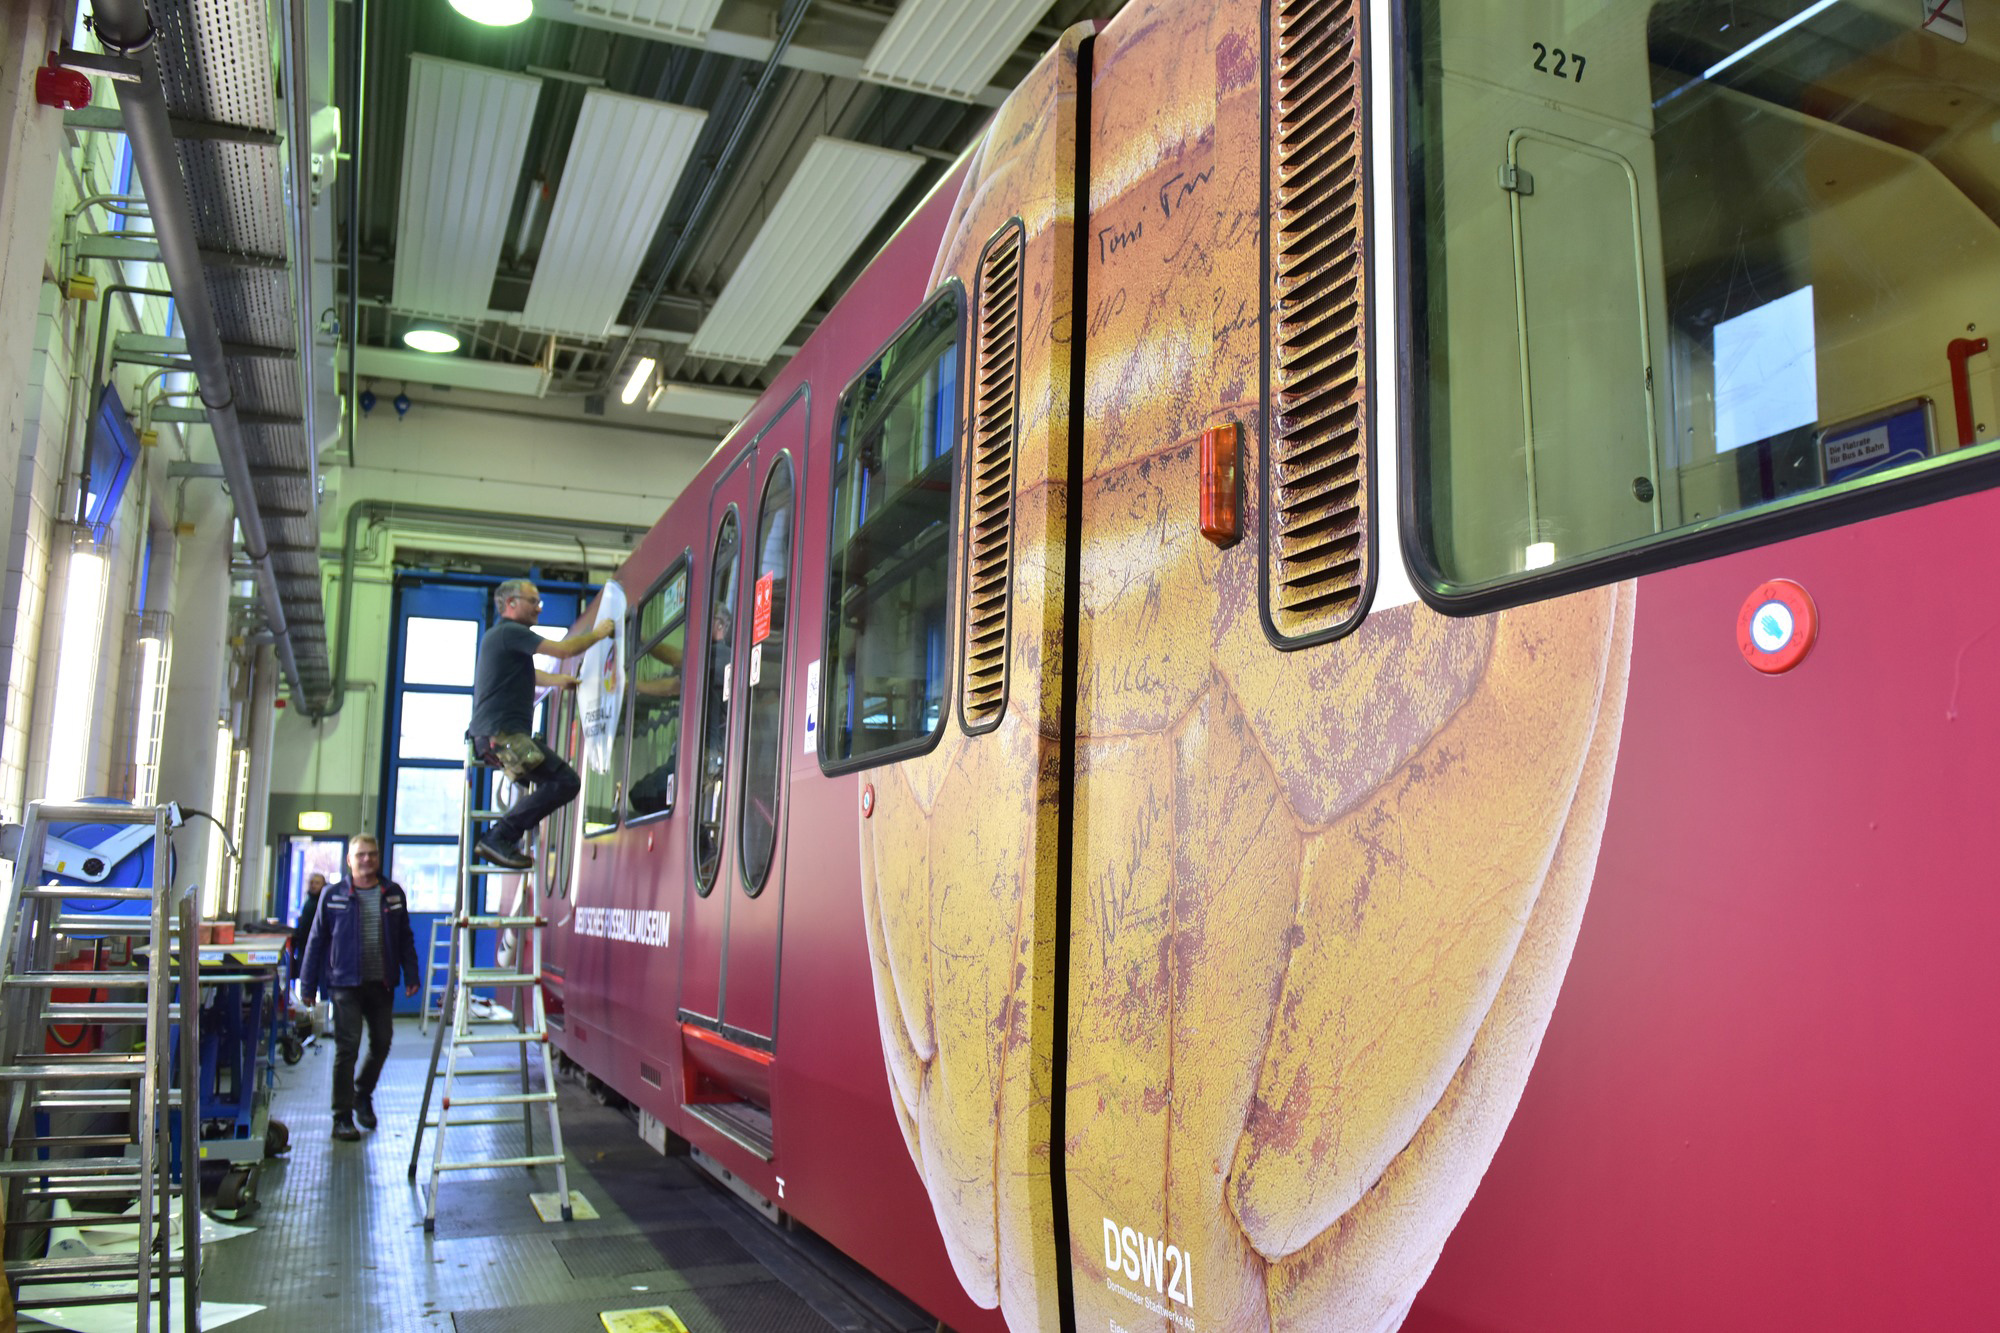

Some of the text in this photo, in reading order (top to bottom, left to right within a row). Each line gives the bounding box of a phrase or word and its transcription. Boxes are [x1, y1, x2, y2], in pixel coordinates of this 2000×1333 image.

[1532, 42, 1586, 83] 227
[1829, 437, 1870, 455] Die Flatrate
[1830, 454, 1841, 464] für
[1842, 452, 1856, 461] Bus
[1865, 443, 1884, 454] Bahn
[1103, 1217, 1193, 1308] DSW21
[1106, 1277, 1195, 1331] Dortmunder Stadtwerke AG
